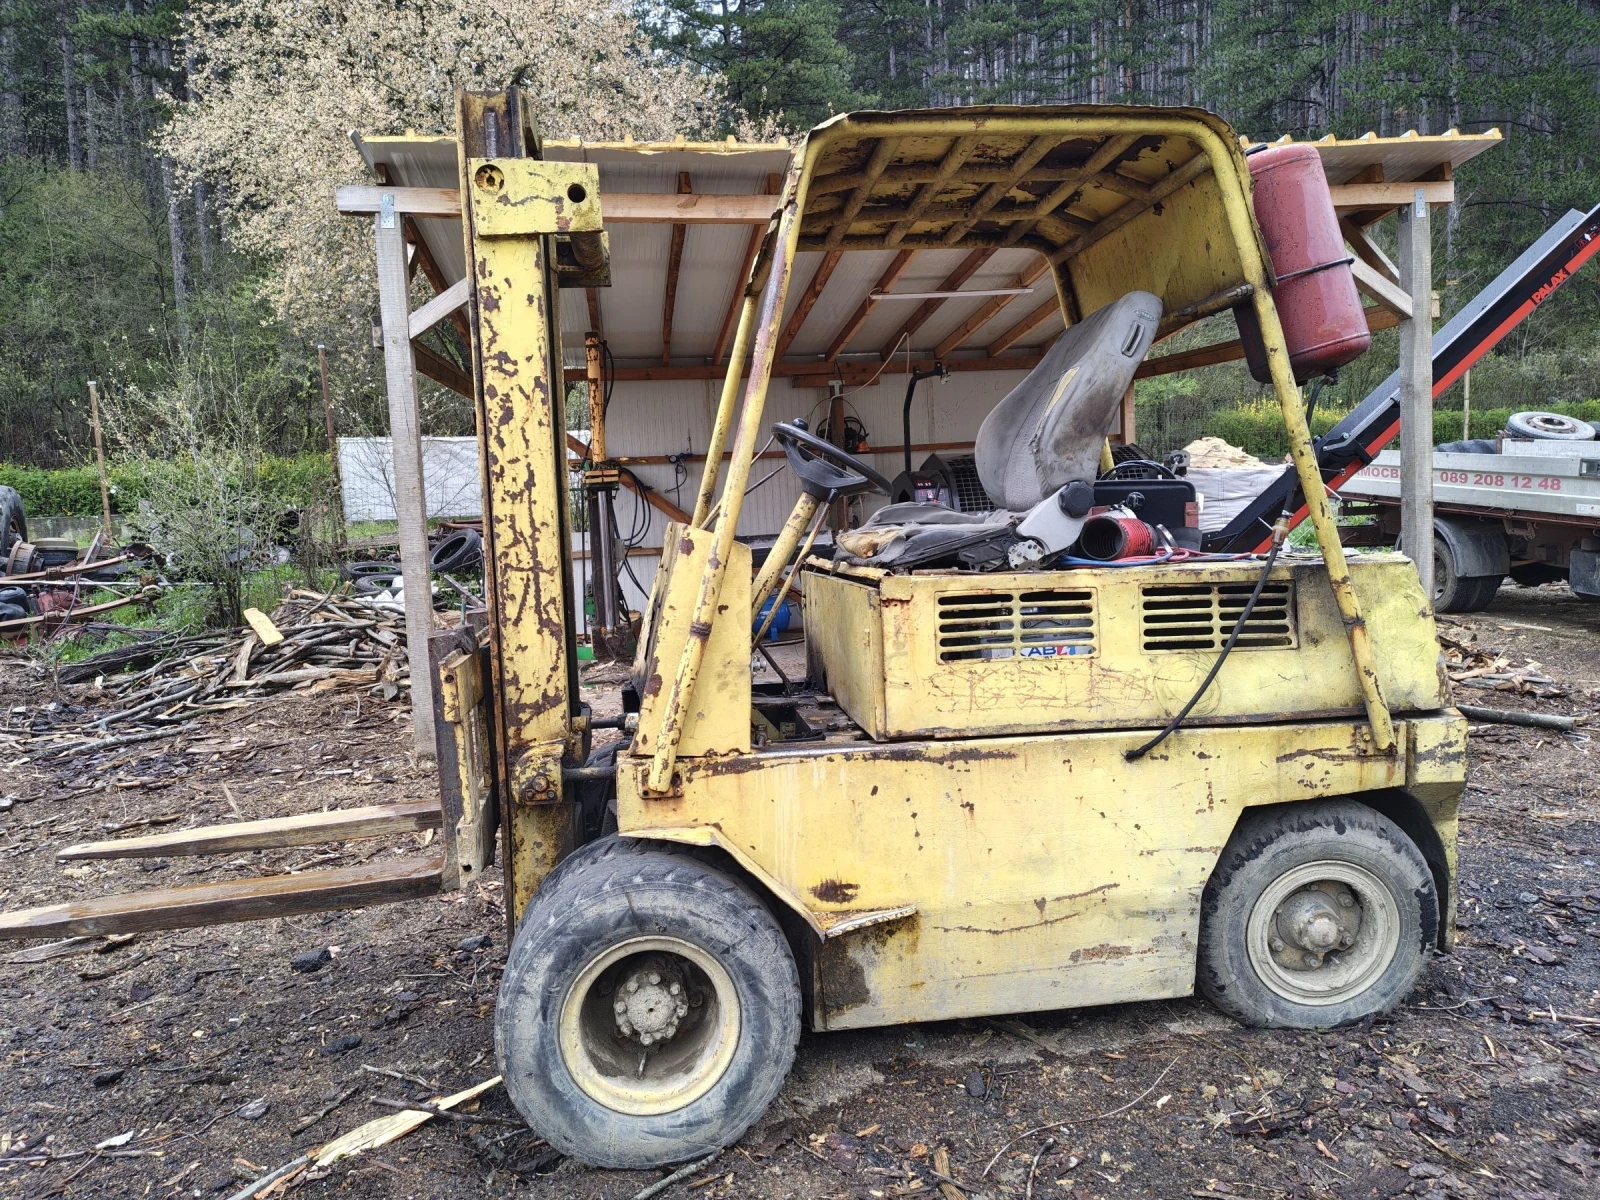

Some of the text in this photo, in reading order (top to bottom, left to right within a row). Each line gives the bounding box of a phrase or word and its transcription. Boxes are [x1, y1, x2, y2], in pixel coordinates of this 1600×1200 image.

[1531, 268, 1569, 304] PALAX
[1356, 467, 1562, 490] МОСВ 089 208 12 48
